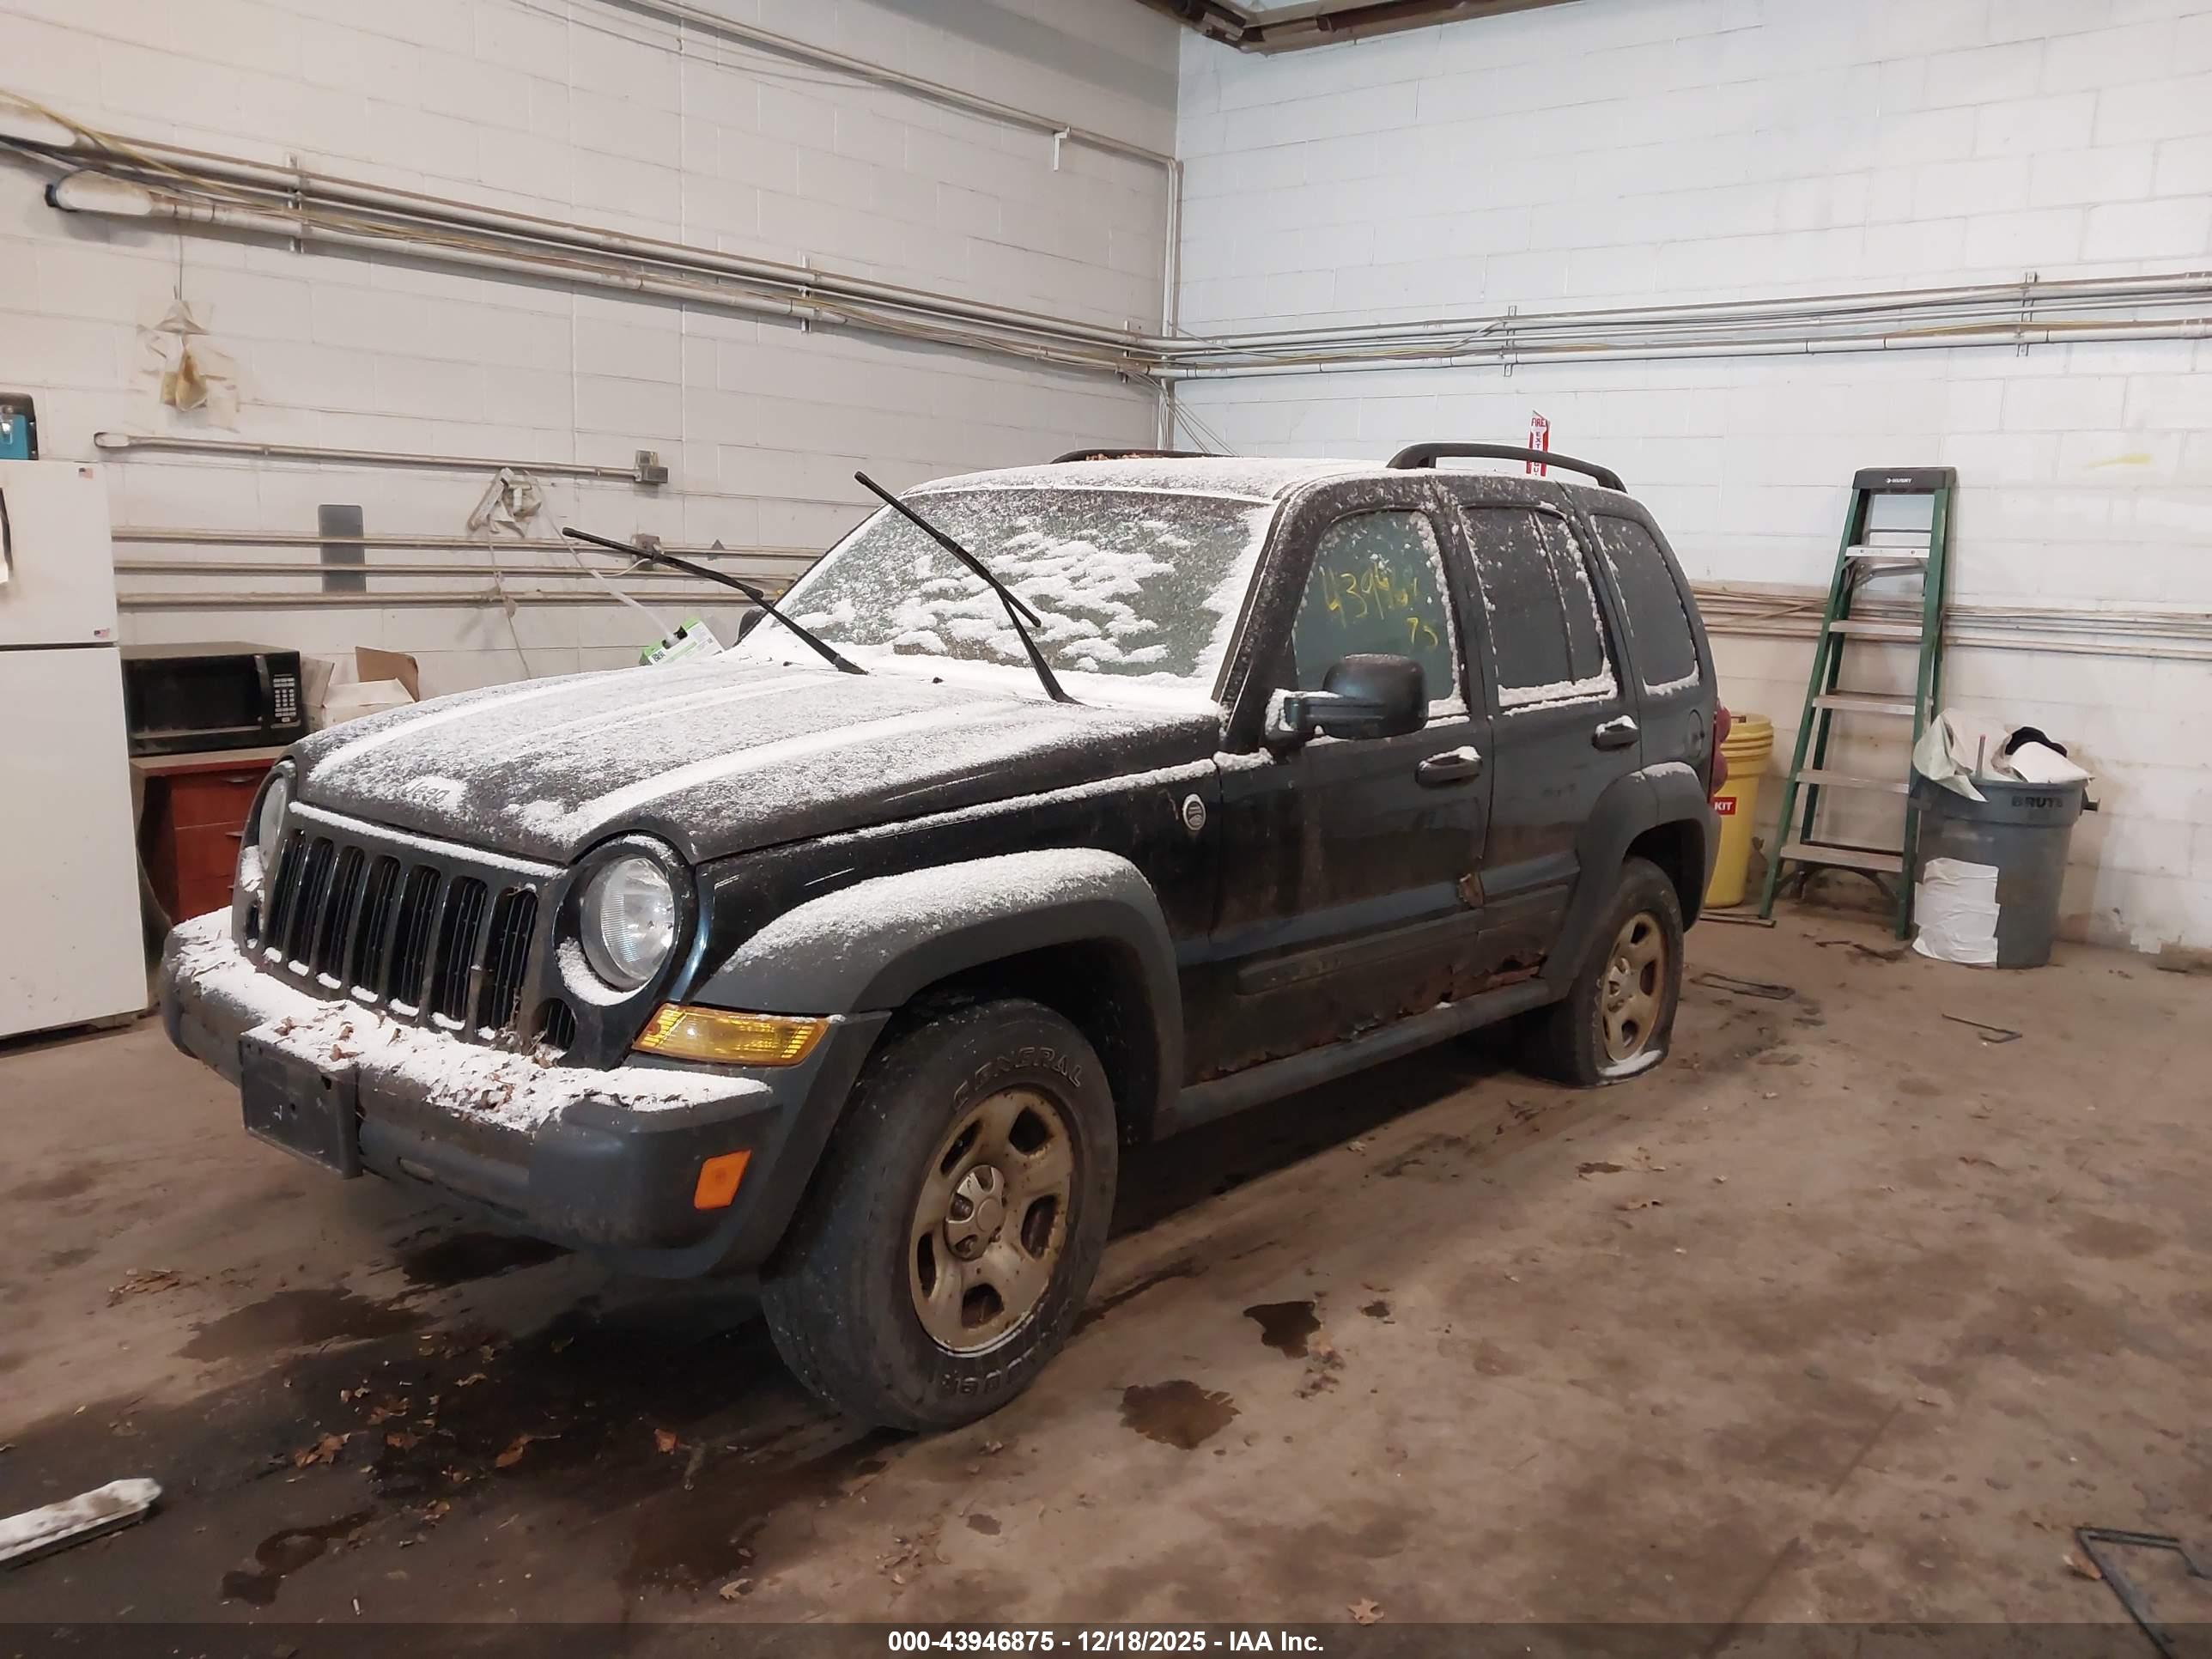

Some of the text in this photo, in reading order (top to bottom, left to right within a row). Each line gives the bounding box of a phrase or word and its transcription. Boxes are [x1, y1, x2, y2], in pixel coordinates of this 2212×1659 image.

[1531, 418, 1547, 427] FIRE
[401, 781, 450, 807] Jeep
[1714, 801, 1733, 811] KIT
[2012, 795, 2063, 808] BRUTE
